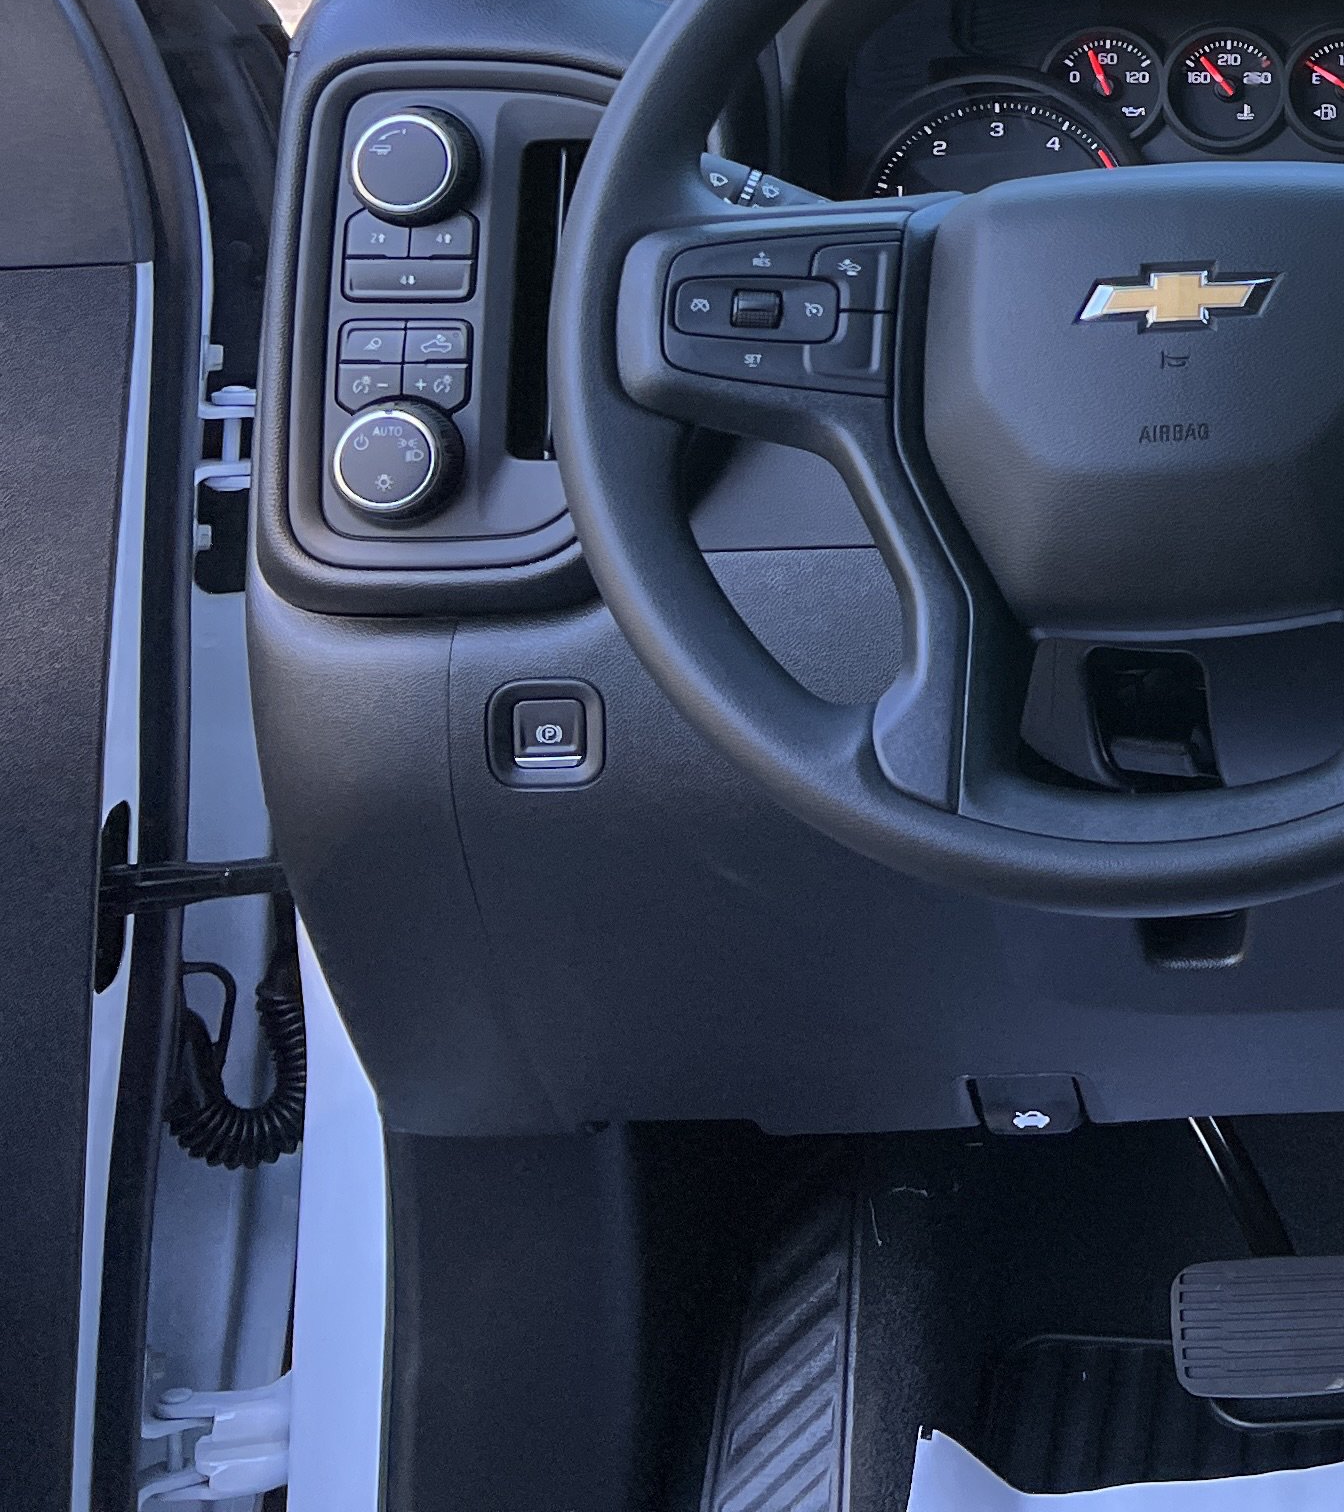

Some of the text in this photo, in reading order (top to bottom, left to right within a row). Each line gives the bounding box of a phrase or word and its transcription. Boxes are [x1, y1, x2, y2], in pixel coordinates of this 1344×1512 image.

[1098, 52, 1118, 65] 60
[1217, 54, 1241, 66] 210
[1069, 71, 1081, 84] 0
[1125, 71, 1151, 84] 120
[1187, 72, 1211, 85] 160
[1311, 72, 1322, 85] E
[990, 122, 1005, 137] 3
[932, 140, 947, 156] 2
[1045, 136, 1061, 152] 4
[752, 257, 772, 269] RES
[744, 353, 762, 365] SET
[372, 425, 404, 438] AUTO
[1139, 422, 1211, 445] AIRBAG
